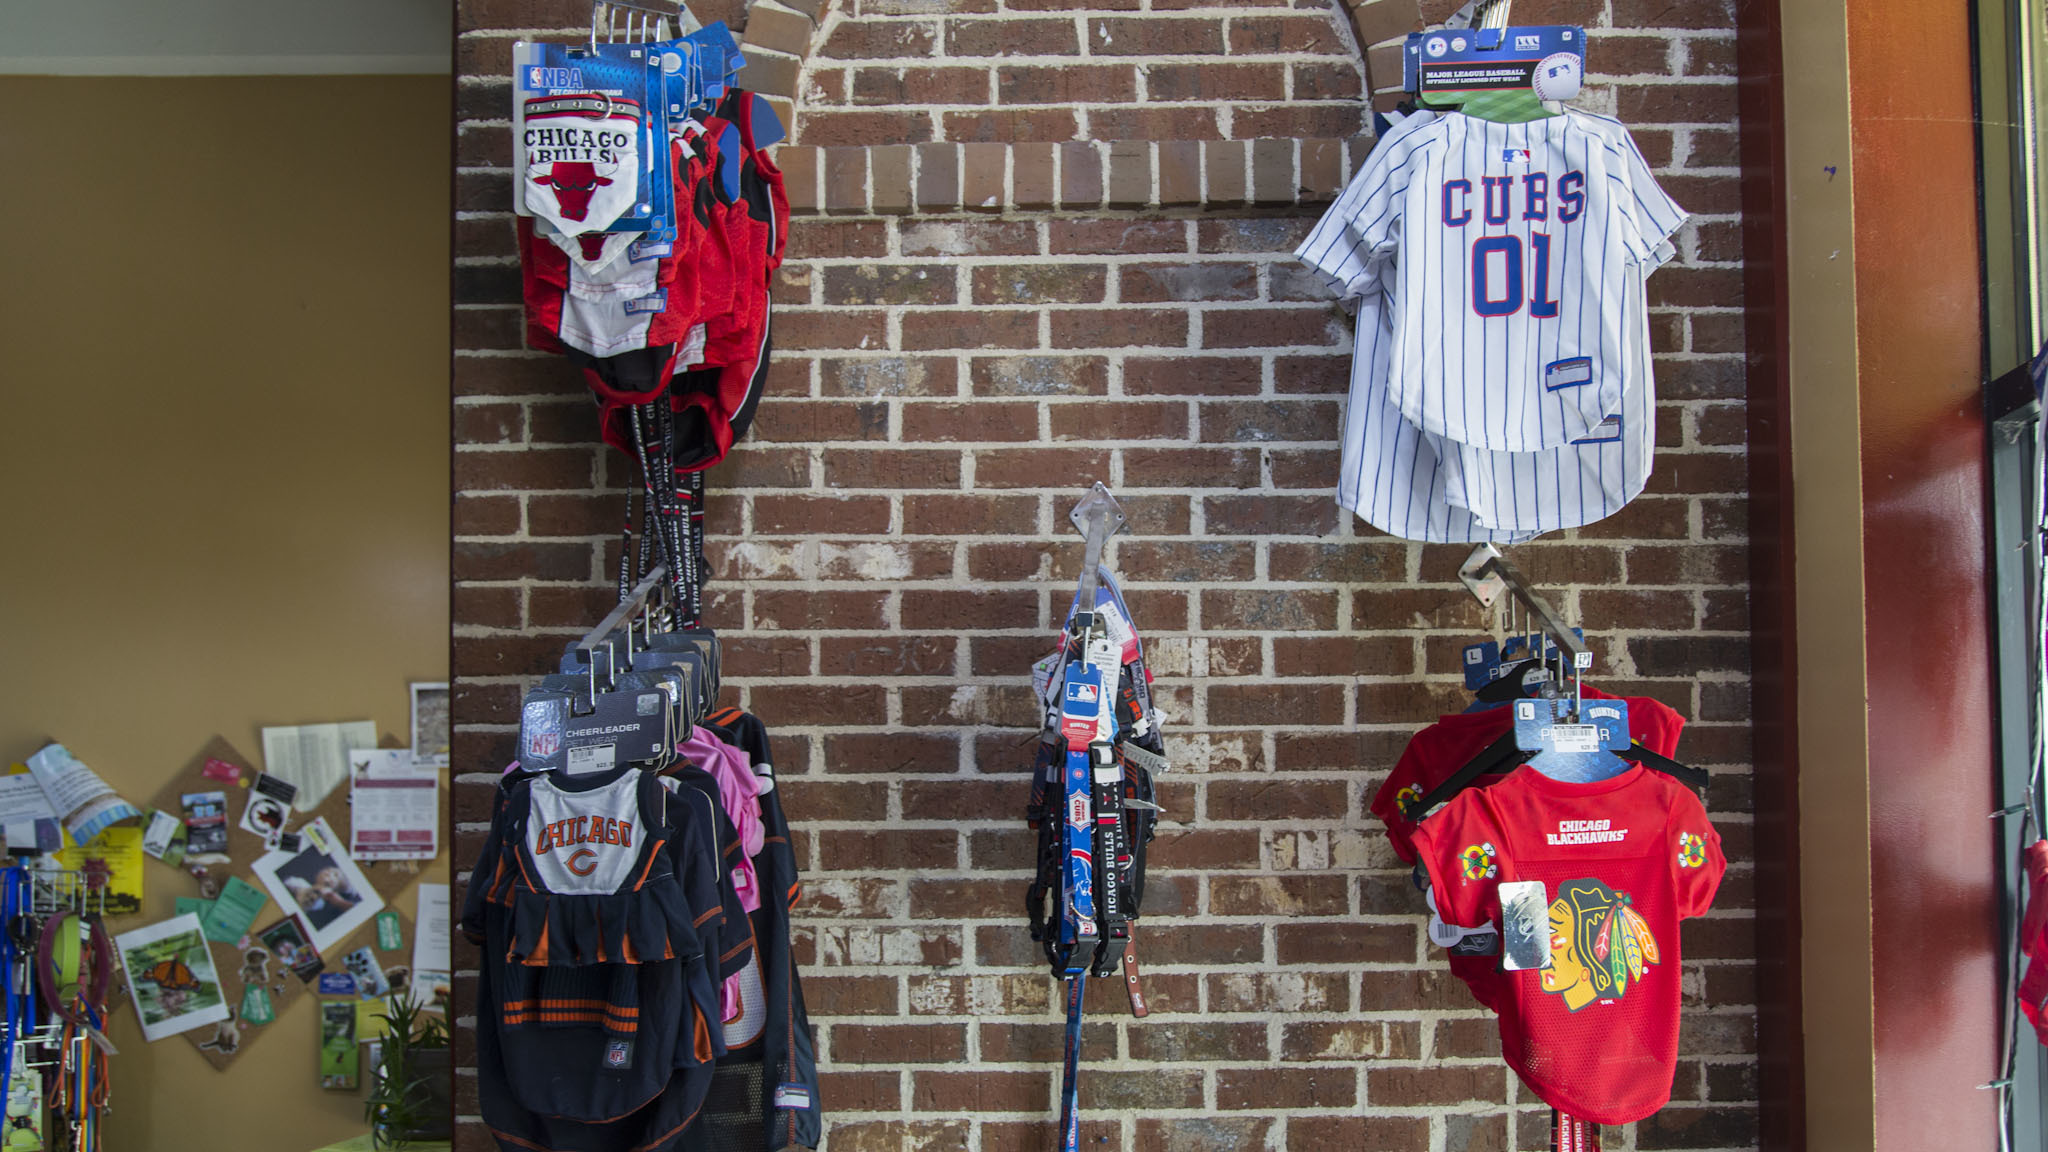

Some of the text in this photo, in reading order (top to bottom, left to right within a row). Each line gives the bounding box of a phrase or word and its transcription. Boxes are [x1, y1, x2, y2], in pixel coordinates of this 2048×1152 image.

[542, 67, 584, 88] NBA
[1454, 70, 1481, 78] LEAGUE
[524, 128, 628, 148] CHICAGO
[1442, 170, 1586, 228] CUBS
[1471, 231, 1559, 318] 01
[681, 504, 692, 583] BULLS CHICAGO
[566, 723, 641, 738] CHEERLEADER
[532, 733, 560, 755] NFL
[565, 735, 618, 748] PET WEAR
[535, 815, 633, 856] CHICAGO
[1559, 819, 1611, 833] CHICAGO
[1546, 830, 1626, 846] BLACKHAWKS
[1104, 832, 1116, 868] BULLS
